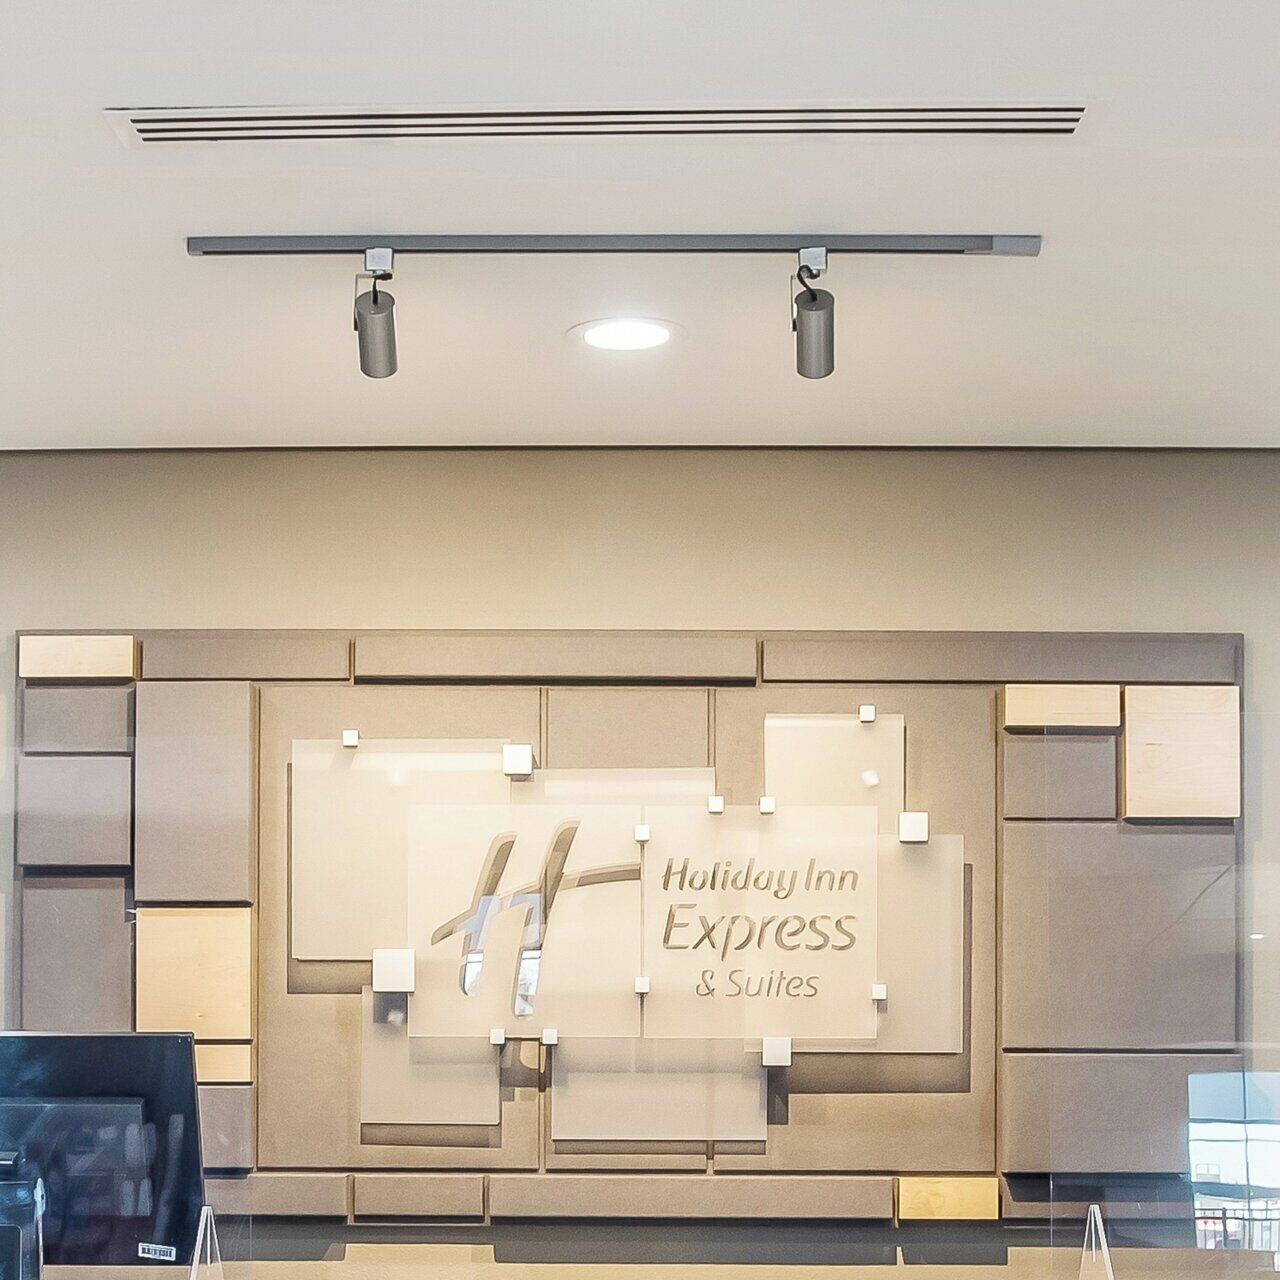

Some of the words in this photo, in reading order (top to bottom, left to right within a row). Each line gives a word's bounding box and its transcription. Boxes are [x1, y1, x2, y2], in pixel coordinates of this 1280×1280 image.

[661, 857, 799, 900] Holiday
[804, 857, 859, 891] Inn
[662, 903, 858, 962] Express
[695, 968, 716, 998] &
[725, 968, 820, 998] Suites
